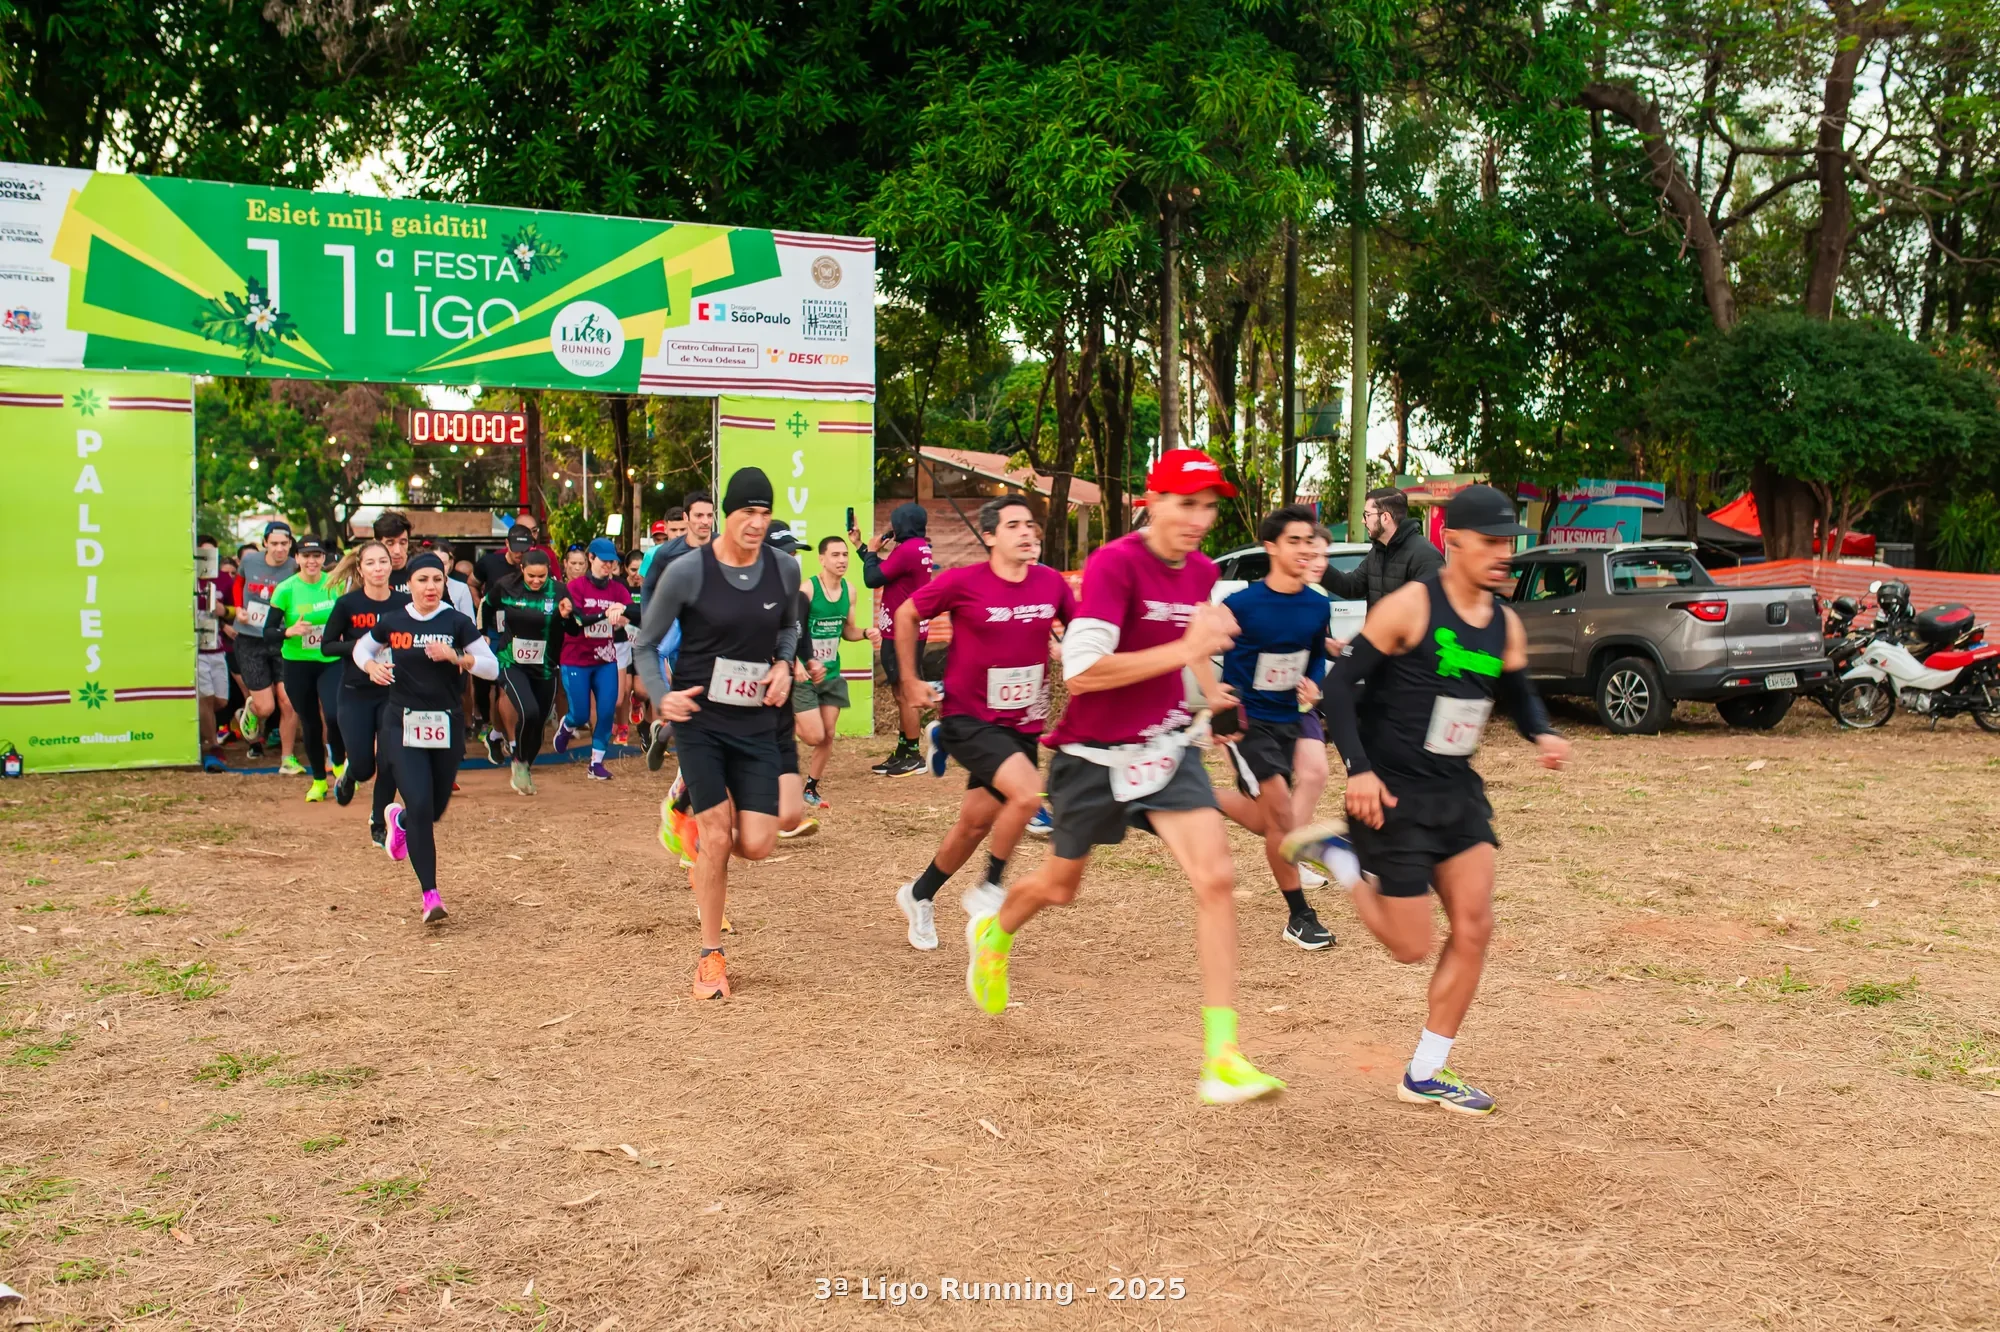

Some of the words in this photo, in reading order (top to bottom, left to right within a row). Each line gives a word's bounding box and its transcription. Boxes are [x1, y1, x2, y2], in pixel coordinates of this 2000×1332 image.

[246, 199, 319, 226] Esiet
[327, 208, 383, 235] mīļi
[391, 214, 487, 239] gaidīti!
[414, 250, 520, 283] FESTA
[731, 311, 791, 325] SãoPaulo
[561, 344, 611, 356] RUNNING
[671, 343, 699, 352] Centro
[701, 344, 736, 353] Cultural
[680, 355, 691, 363] de
[715, 357, 746, 365] Odessa
[788, 352, 849, 366] DESKTOP
[414, 412, 524, 443] 00:00:02
[1550, 529, 1606, 544] MILKSHAKE
[74, 430, 104, 673] PALDIES
[352, 613, 375, 628] 100
[389, 632, 413, 649] 100
[413, 634, 454, 644] LIMITES
[517, 649, 539, 659] 057
[725, 678, 758, 698] 148
[1000, 683, 1034, 701] 023
[28, 730, 154, 747] @centroculturalleto
[414, 726, 445, 741] 136
